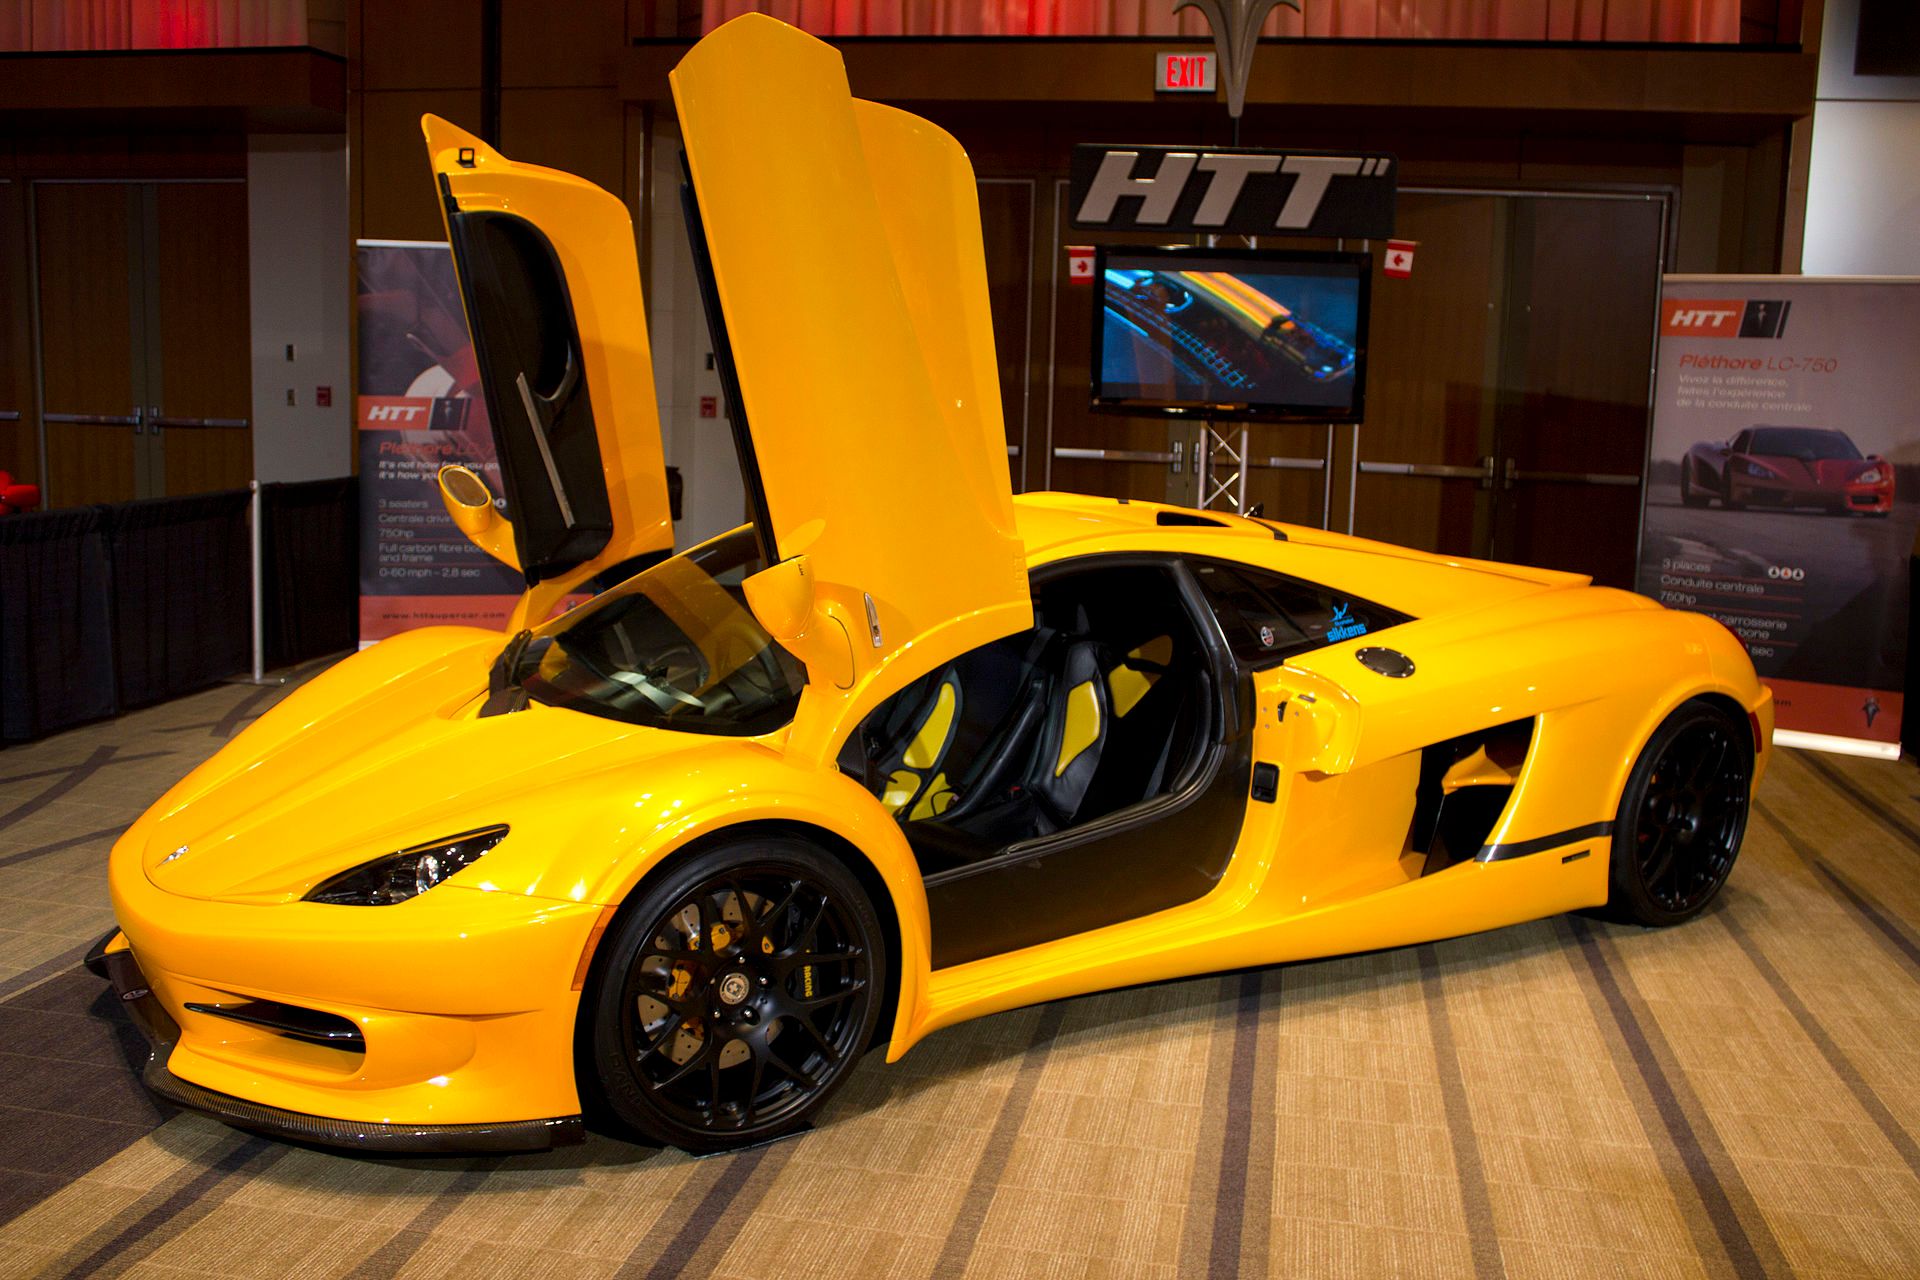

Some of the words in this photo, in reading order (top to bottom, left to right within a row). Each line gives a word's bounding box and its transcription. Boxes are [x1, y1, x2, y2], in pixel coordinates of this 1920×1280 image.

[1166, 56, 1207, 88] EXIT
[1679, 354, 1762, 370] Pléthore
[1767, 357, 1838, 373] LC-750
[1679, 374, 1709, 385] Vivez
[1712, 375, 1723, 385] la
[1678, 386, 1709, 396] faites
[1677, 398, 1692, 408] de
[1695, 398, 1705, 408] la
[1708, 399, 1759, 409] conduite
[1762, 401, 1812, 412] centrale
[367, 405, 426, 420] HTT
[398, 461, 415, 469] not
[417, 461, 439, 470] how
[398, 471, 420, 480] how
[379, 499, 386, 509] 3
[388, 500, 429, 509] seaters
[378, 514, 424, 523] Centrale
[379, 528, 415, 538] 750hp
[379, 543, 397, 553] Full
[398, 543, 437, 553] carbon
[439, 543, 463, 553] fibre
[379, 554, 400, 563] and
[402, 554, 433, 563] frame
[1663, 558, 1670, 570] 3
[1673, 559, 1711, 573] places
[379, 567, 406, 578] 0-60
[408, 568, 432, 579] mph
[461, 568, 480, 578] sec
[1661, 575, 1713, 590] Conduite
[1715, 582, 1765, 594] centrale
[1661, 590, 1697, 605] 750hp
[1327, 623, 1367, 643] sikkens
[1751, 646, 1775, 657] sec
